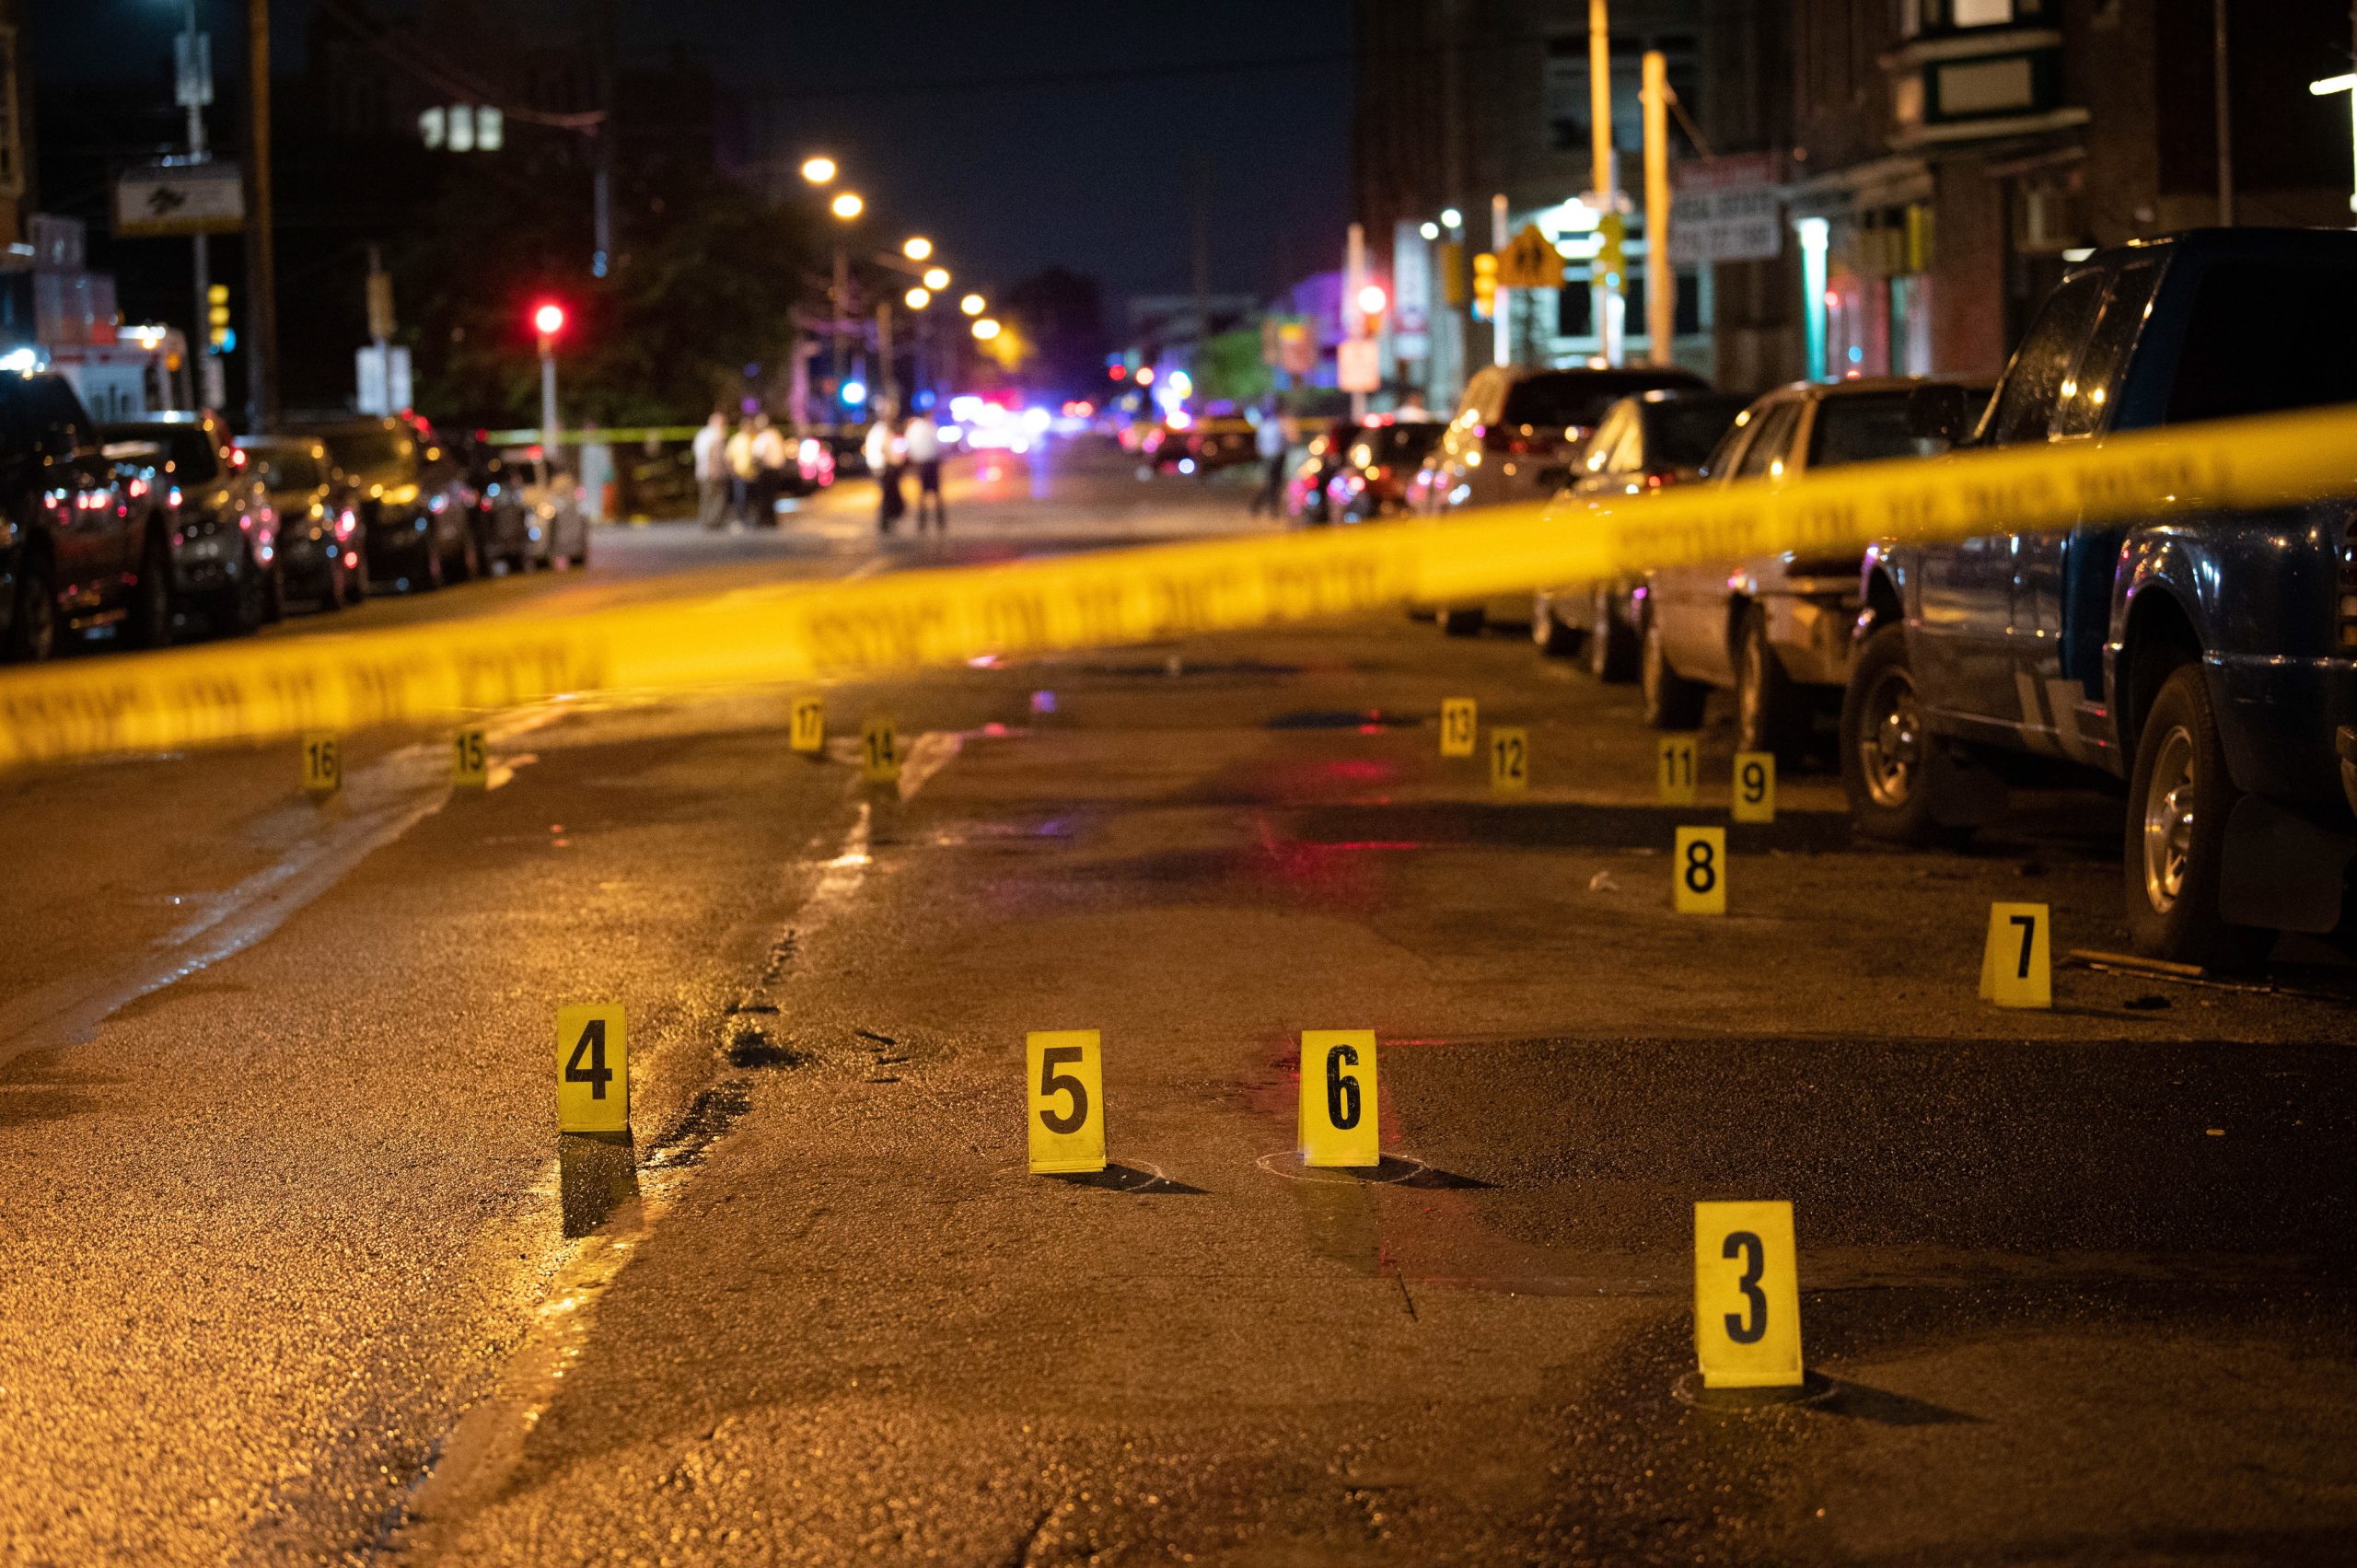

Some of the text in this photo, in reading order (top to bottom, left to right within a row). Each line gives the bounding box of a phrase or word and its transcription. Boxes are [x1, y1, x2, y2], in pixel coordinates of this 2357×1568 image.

[1446, 707, 1470, 744] 13
[308, 741, 336, 780] 16
[457, 733, 483, 772] 15
[867, 730, 895, 766] 14
[1495, 738, 1523, 778] 12
[1664, 748, 1692, 786] 11
[1743, 761, 1766, 804] 9
[1686, 841, 1715, 893] 8
[2010, 916, 2035, 978] 7
[565, 1020, 612, 1099] 4
[1040, 1047, 1087, 1134] 5
[1327, 1045, 1361, 1130] 6
[1723, 1231, 1767, 1344] 3
